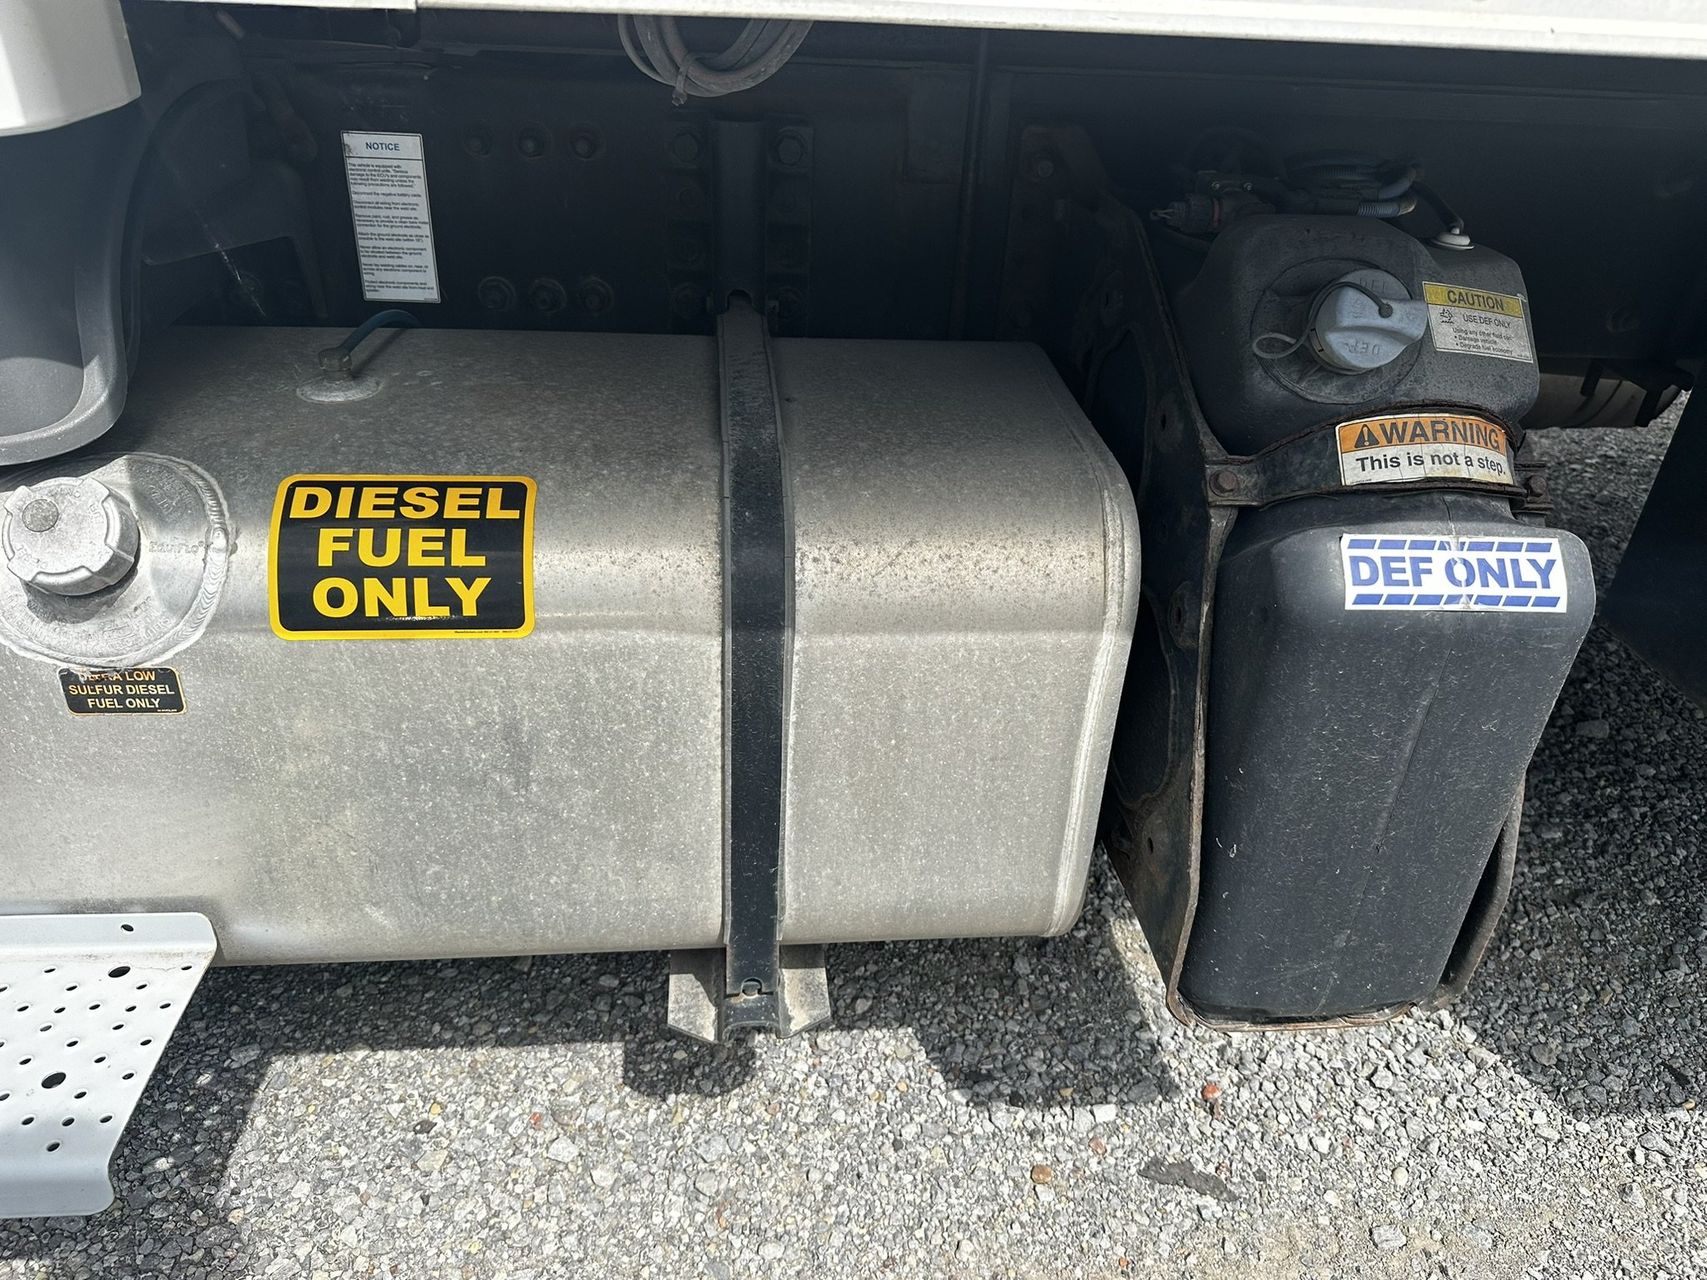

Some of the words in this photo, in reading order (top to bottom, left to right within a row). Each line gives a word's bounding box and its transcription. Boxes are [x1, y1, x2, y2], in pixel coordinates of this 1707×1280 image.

[365, 142, 400, 151] NOTICE
[1447, 290, 1505, 311] CAUTION
[1462, 314, 1478, 324] USE
[1479, 316, 1493, 325] DEF
[1493, 319, 1511, 329] ONLY
[1452, 327, 1468, 335] Using
[1459, 342, 1481, 350] Degrade
[1379, 420, 1500, 451] WARNING
[1356, 454, 1401, 472] This
[1407, 452, 1424, 466] is
[1431, 452, 1460, 466] not
[1464, 457, 1474, 467] a
[1477, 456, 1506, 476] step.
[289, 486, 521, 519] DIESEL
[317, 527, 486, 567] FUEL
[1349, 555, 1433, 587] DEF
[1445, 557, 1557, 589] ONLY
[312, 577, 492, 618] ONLY
[125, 671, 156, 681] LOW
[68, 684, 123, 695] SULFUR
[125, 684, 175, 695] DIESEL
[87, 698, 123, 709] FUEL
[125, 698, 161, 708] ONLY
